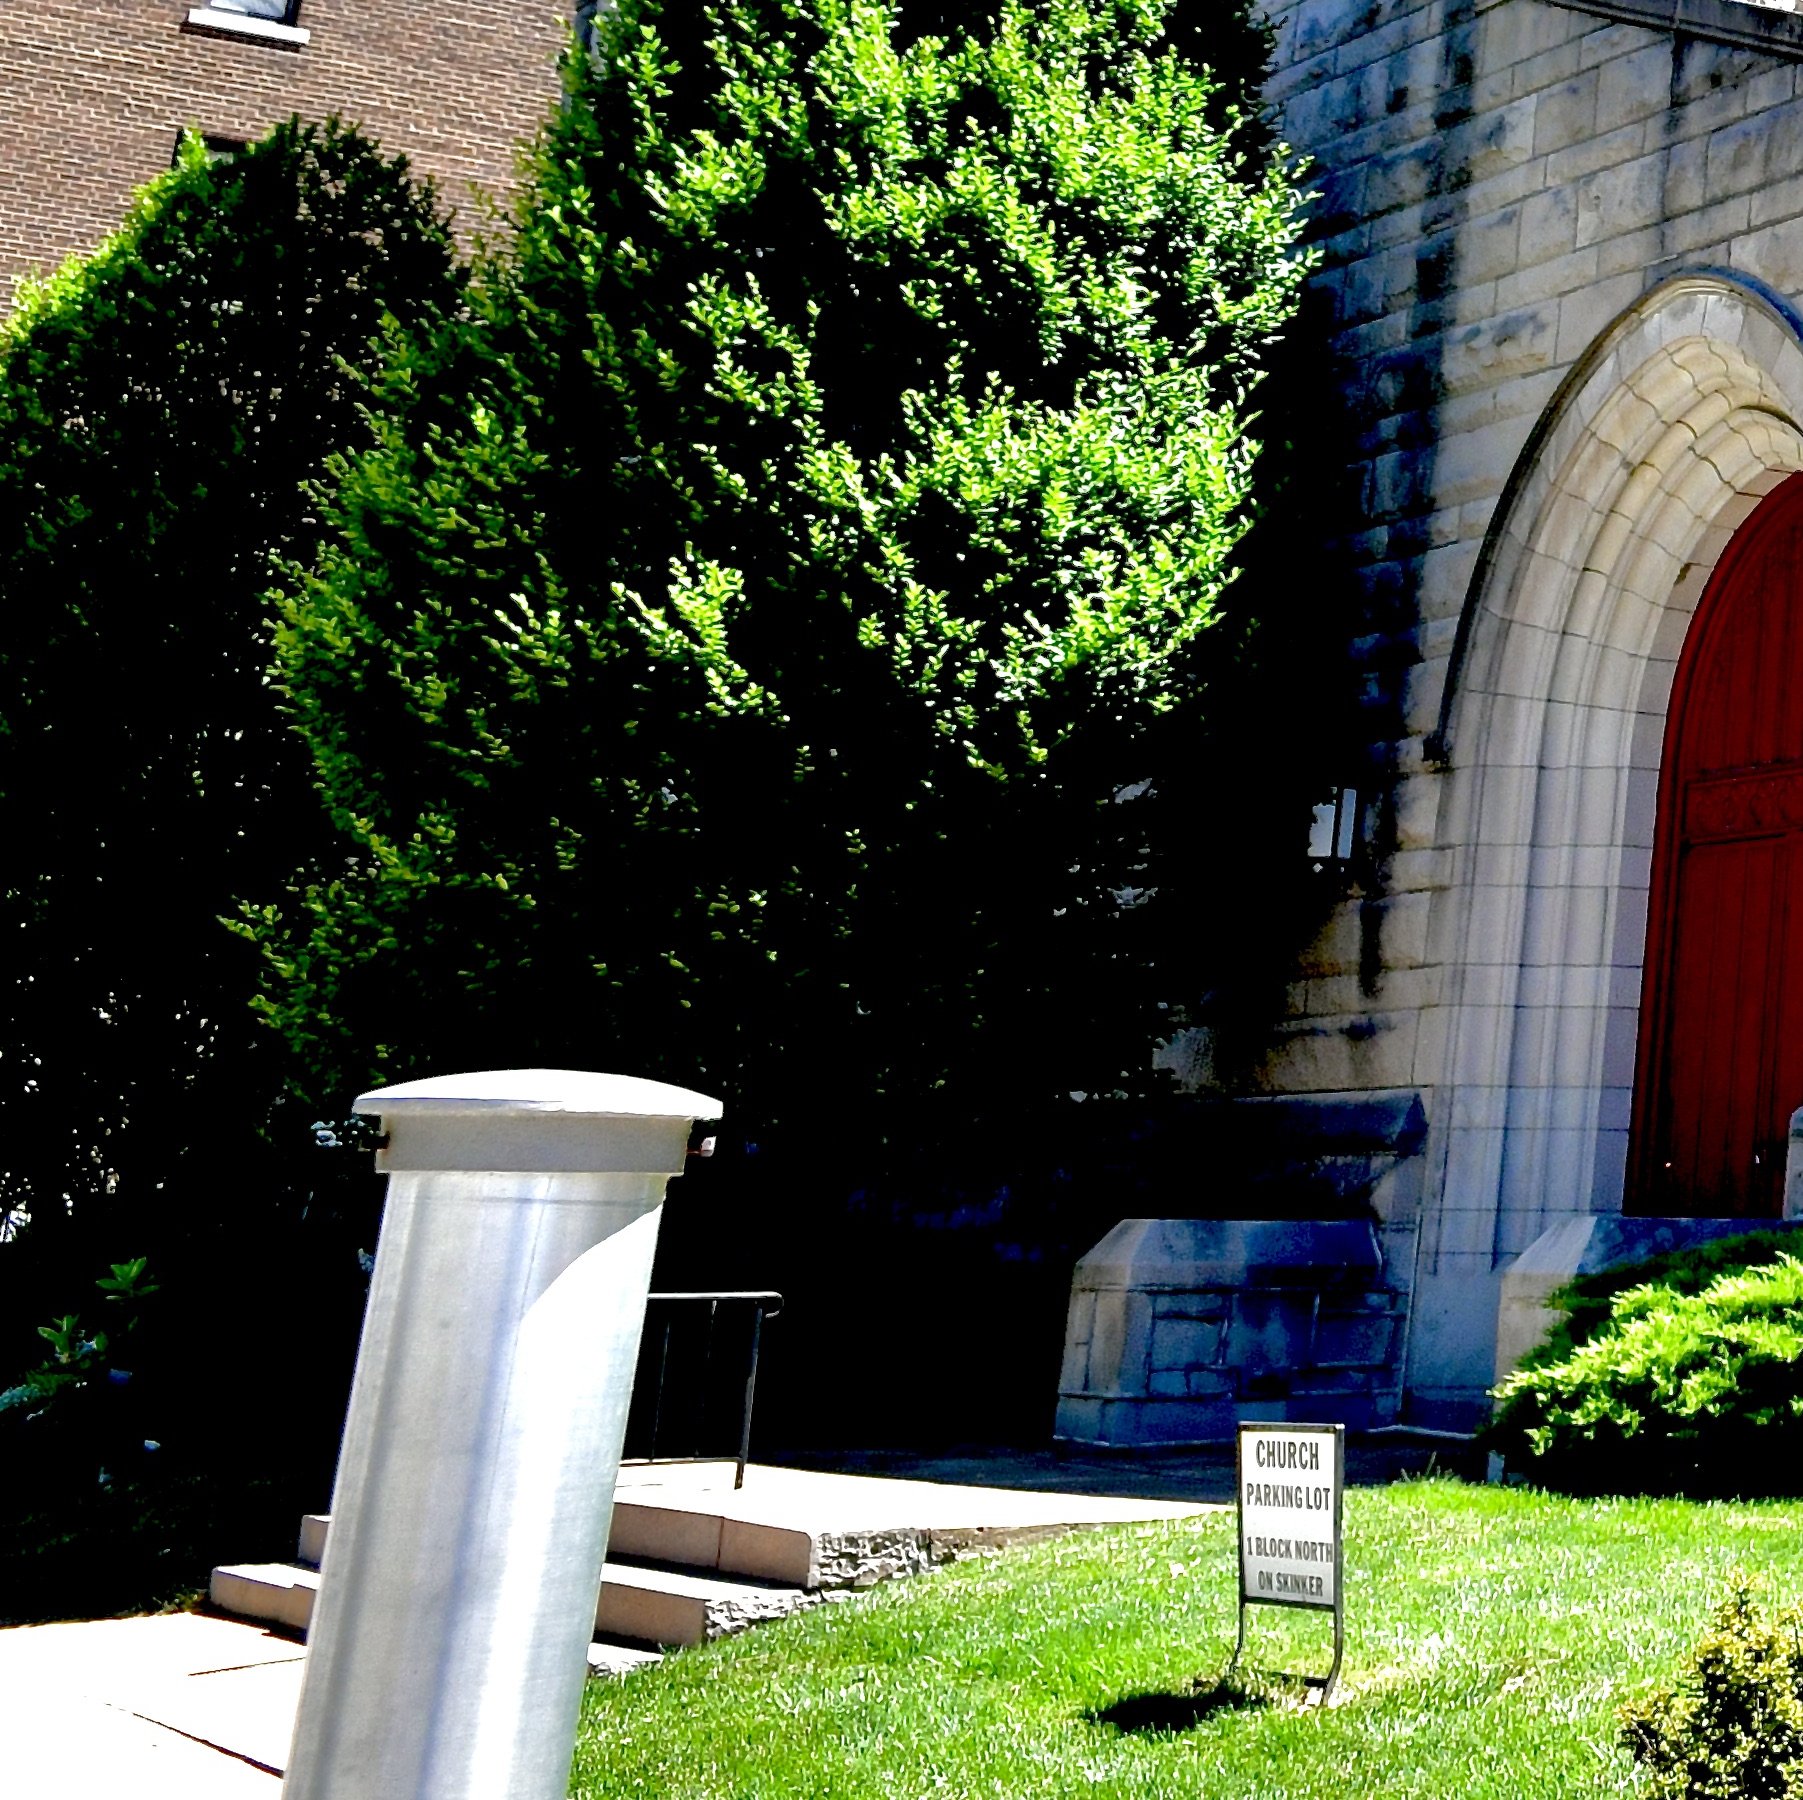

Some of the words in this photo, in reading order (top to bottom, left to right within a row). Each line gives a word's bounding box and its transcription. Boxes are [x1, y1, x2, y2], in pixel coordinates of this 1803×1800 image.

[1255, 1439, 1320, 1471] CHURCH
[1246, 1483, 1303, 1509] PARKING
[1306, 1486, 1331, 1511] LOT
[1246, 1536, 1252, 1556] 1
[1256, 1536, 1293, 1560] BLOCK
[1295, 1540, 1334, 1563] NORTH
[1257, 1570, 1273, 1591] ON
[1276, 1572, 1323, 1597] SKINKER
